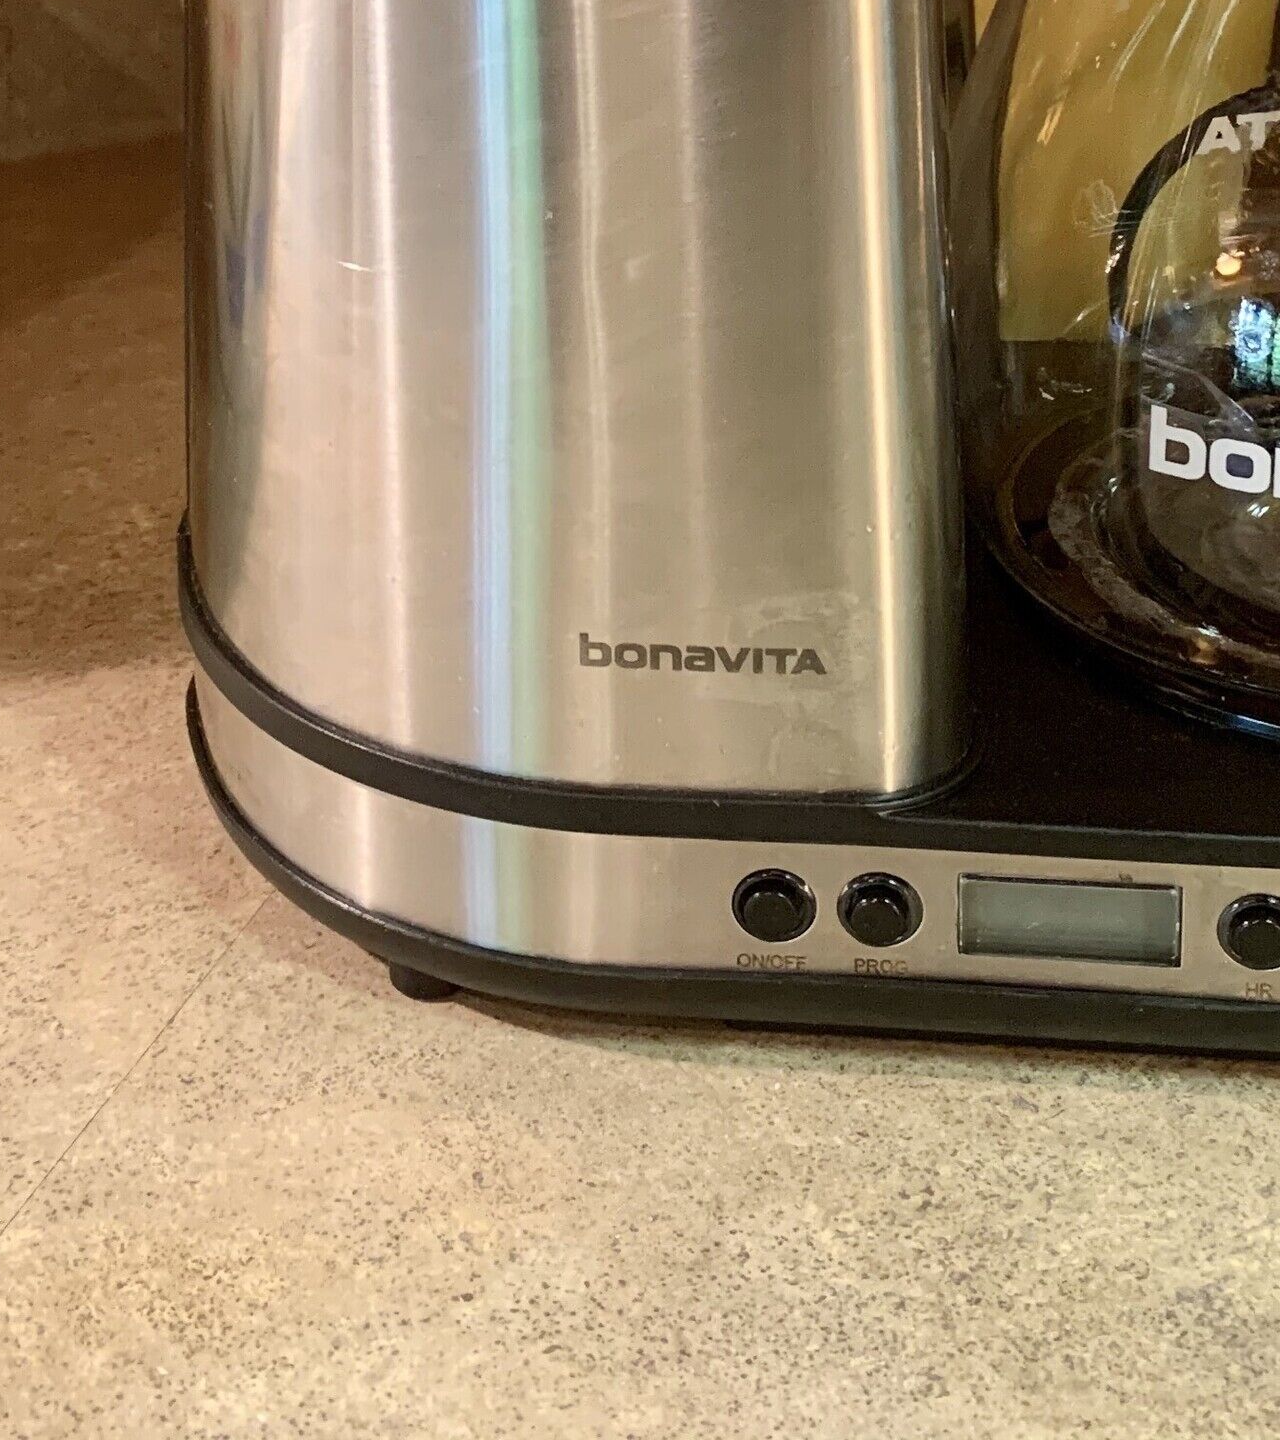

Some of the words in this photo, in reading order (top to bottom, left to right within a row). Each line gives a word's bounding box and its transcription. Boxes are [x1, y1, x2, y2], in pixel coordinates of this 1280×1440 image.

[736, 952, 808, 971] ON/OFF
[853, 957, 909, 976] PROG
[1244, 981, 1273, 1000] HR
